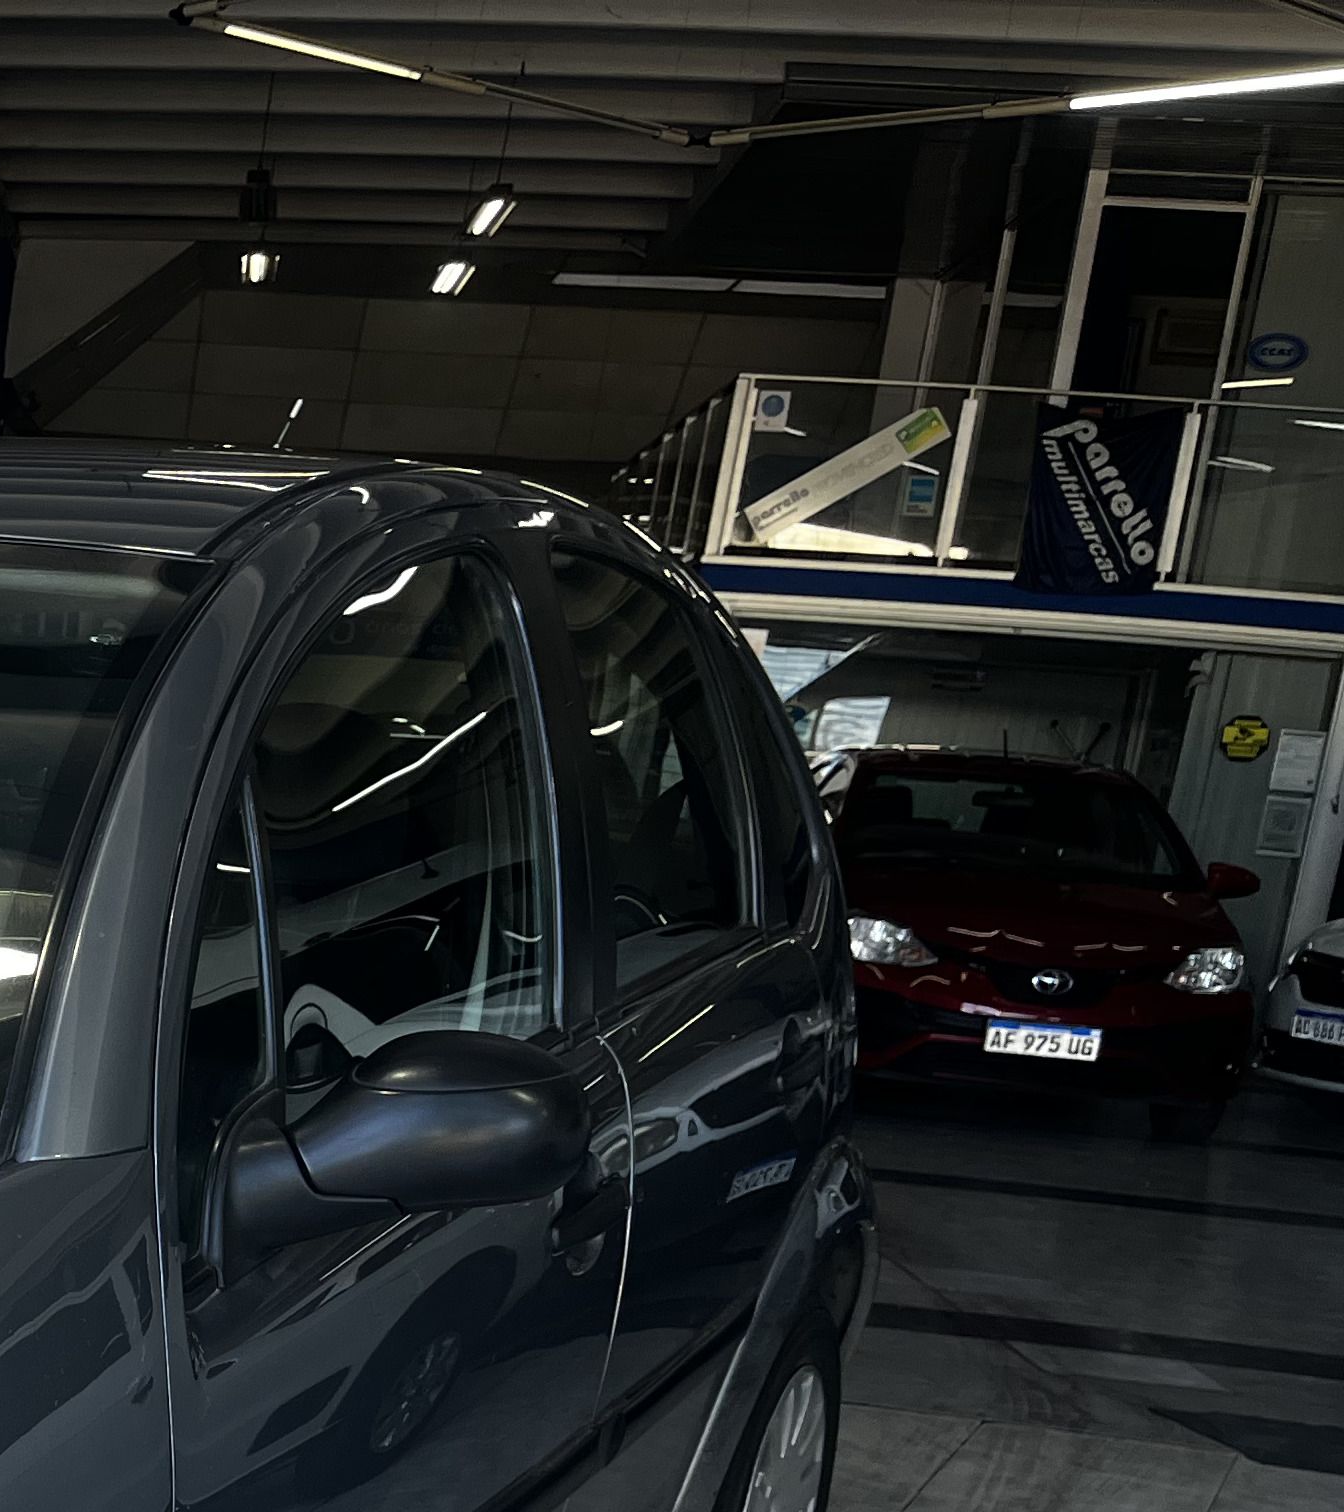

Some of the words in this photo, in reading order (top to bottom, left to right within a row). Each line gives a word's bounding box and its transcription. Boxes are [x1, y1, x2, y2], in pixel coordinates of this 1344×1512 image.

[1043, 439, 1119, 583] multimarcas
[989, 1029, 1016, 1048] AF
[1024, 1033, 1061, 1053] 975
[1067, 1038, 1094, 1056] UG
